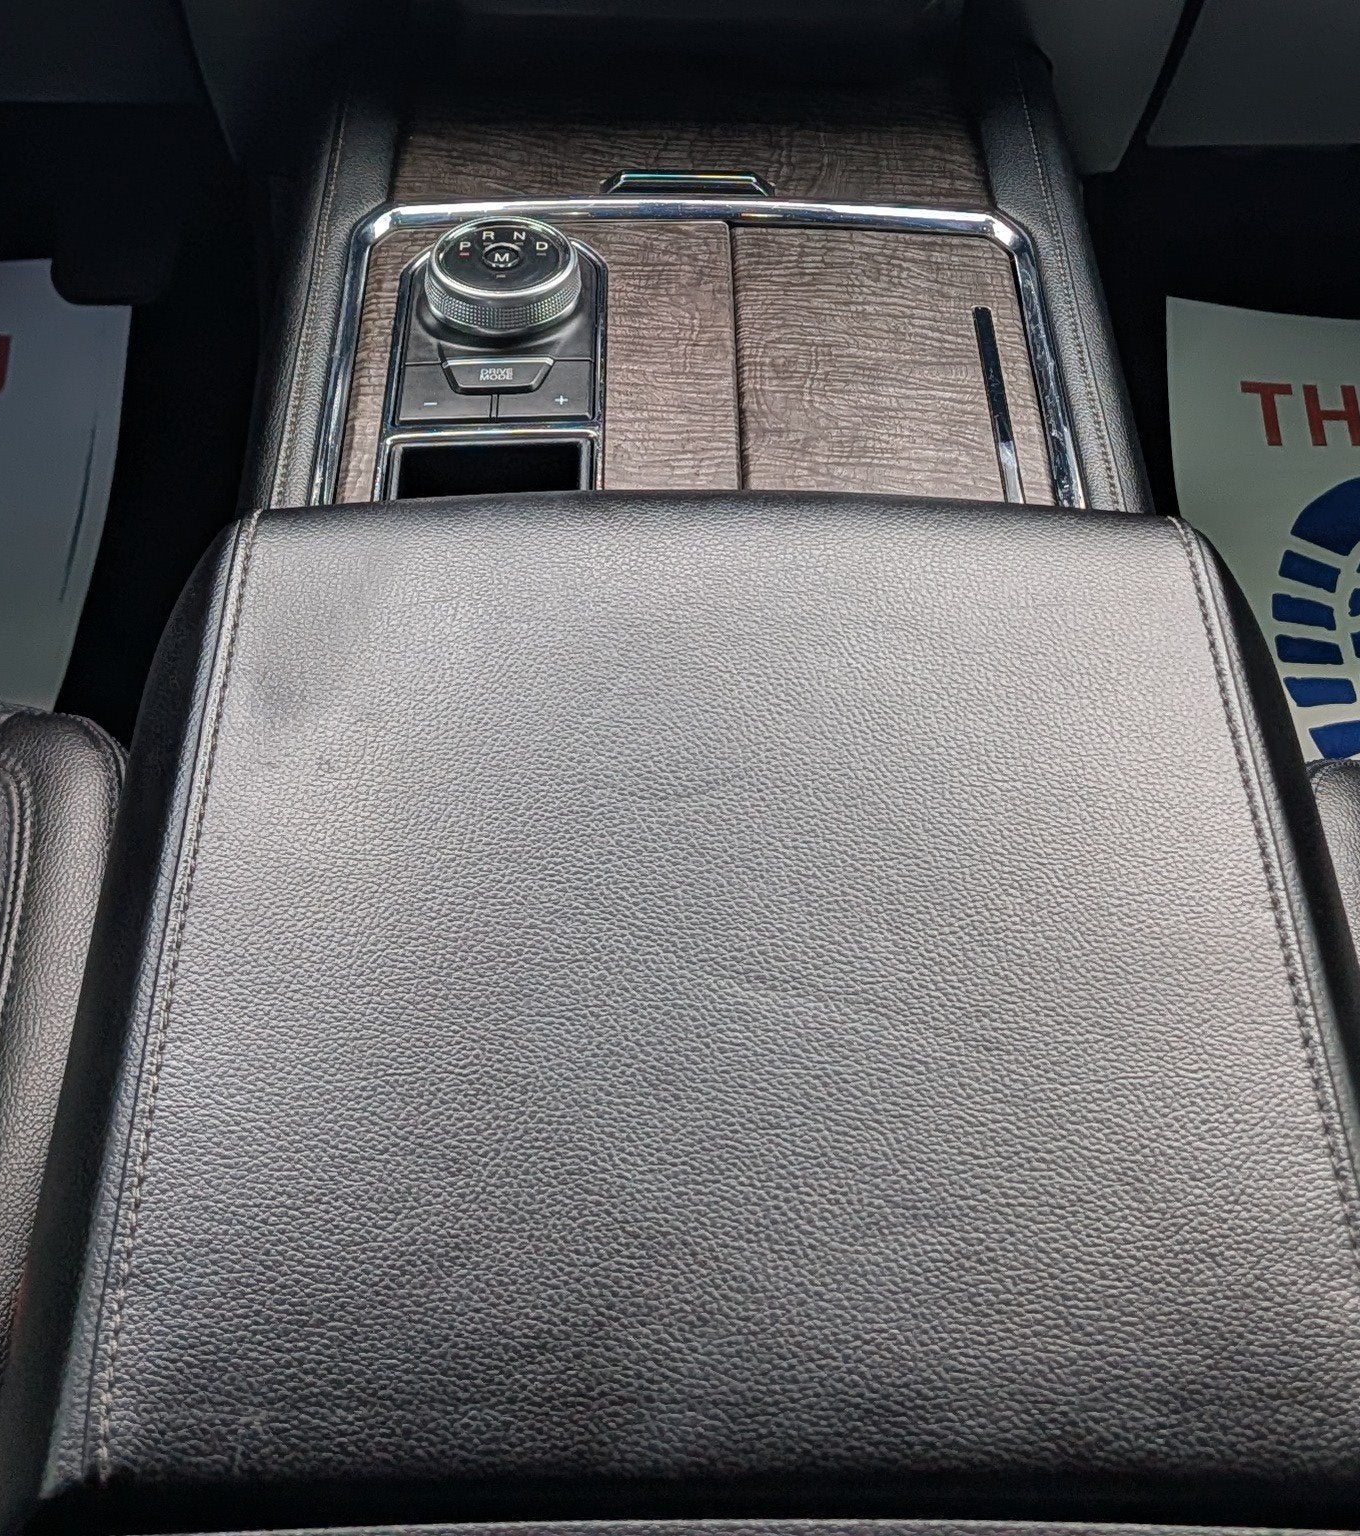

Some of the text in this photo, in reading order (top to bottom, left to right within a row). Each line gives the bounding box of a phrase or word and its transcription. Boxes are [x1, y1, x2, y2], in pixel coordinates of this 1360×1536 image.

[483, 231, 495, 240] R
[513, 231, 526, 240] N
[459, 241, 471, 251] P
[536, 241, 549, 251] D
[494, 252, 510, 262] M
[479, 373, 514, 381] MODE
